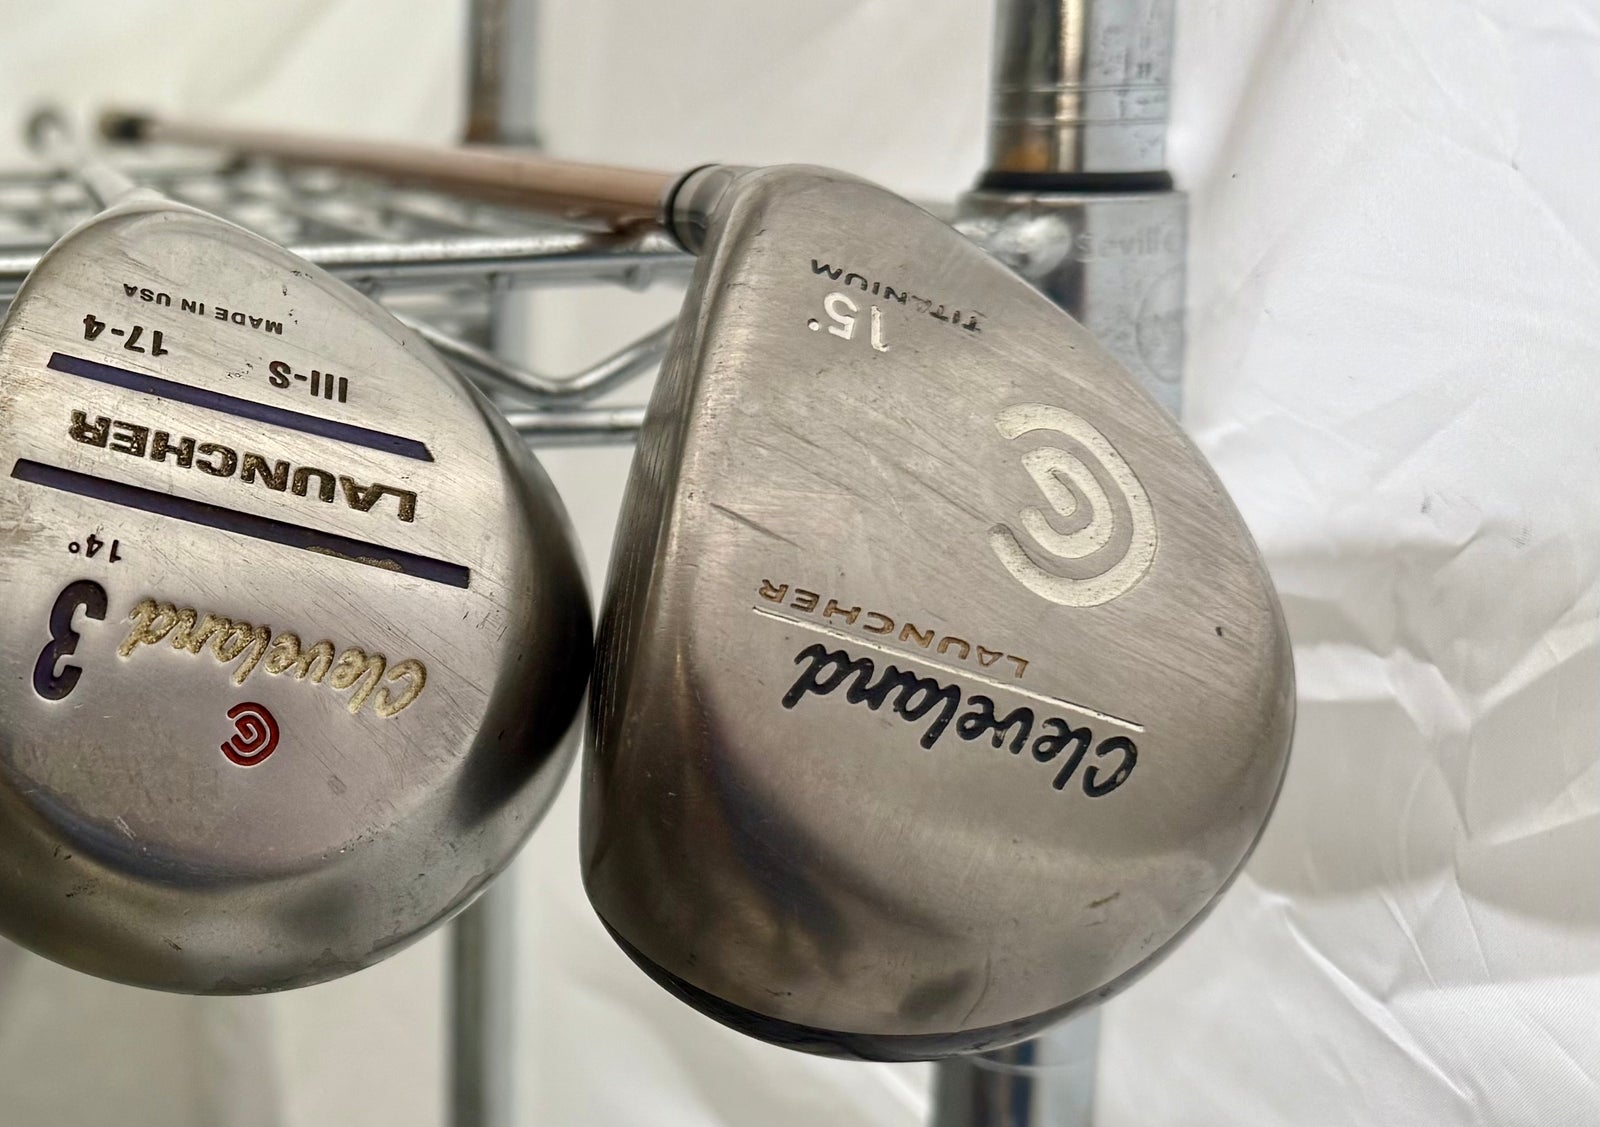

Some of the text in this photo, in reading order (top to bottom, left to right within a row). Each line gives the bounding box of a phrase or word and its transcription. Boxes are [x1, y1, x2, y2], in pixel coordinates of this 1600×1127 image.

[123, 283, 282, 335] MADE IN USA
[811, 258, 981, 333] TITANIUM
[83, 314, 348, 403] III-S 17-4
[68, 410, 417, 522] LAUNCHER
[68, 533, 121, 563] 14°
[33, 579, 108, 701] 3
[118, 598, 427, 718] Cleveland
[757, 579, 1029, 678] LAUNCHER
[781, 644, 1139, 797] Cleveland
